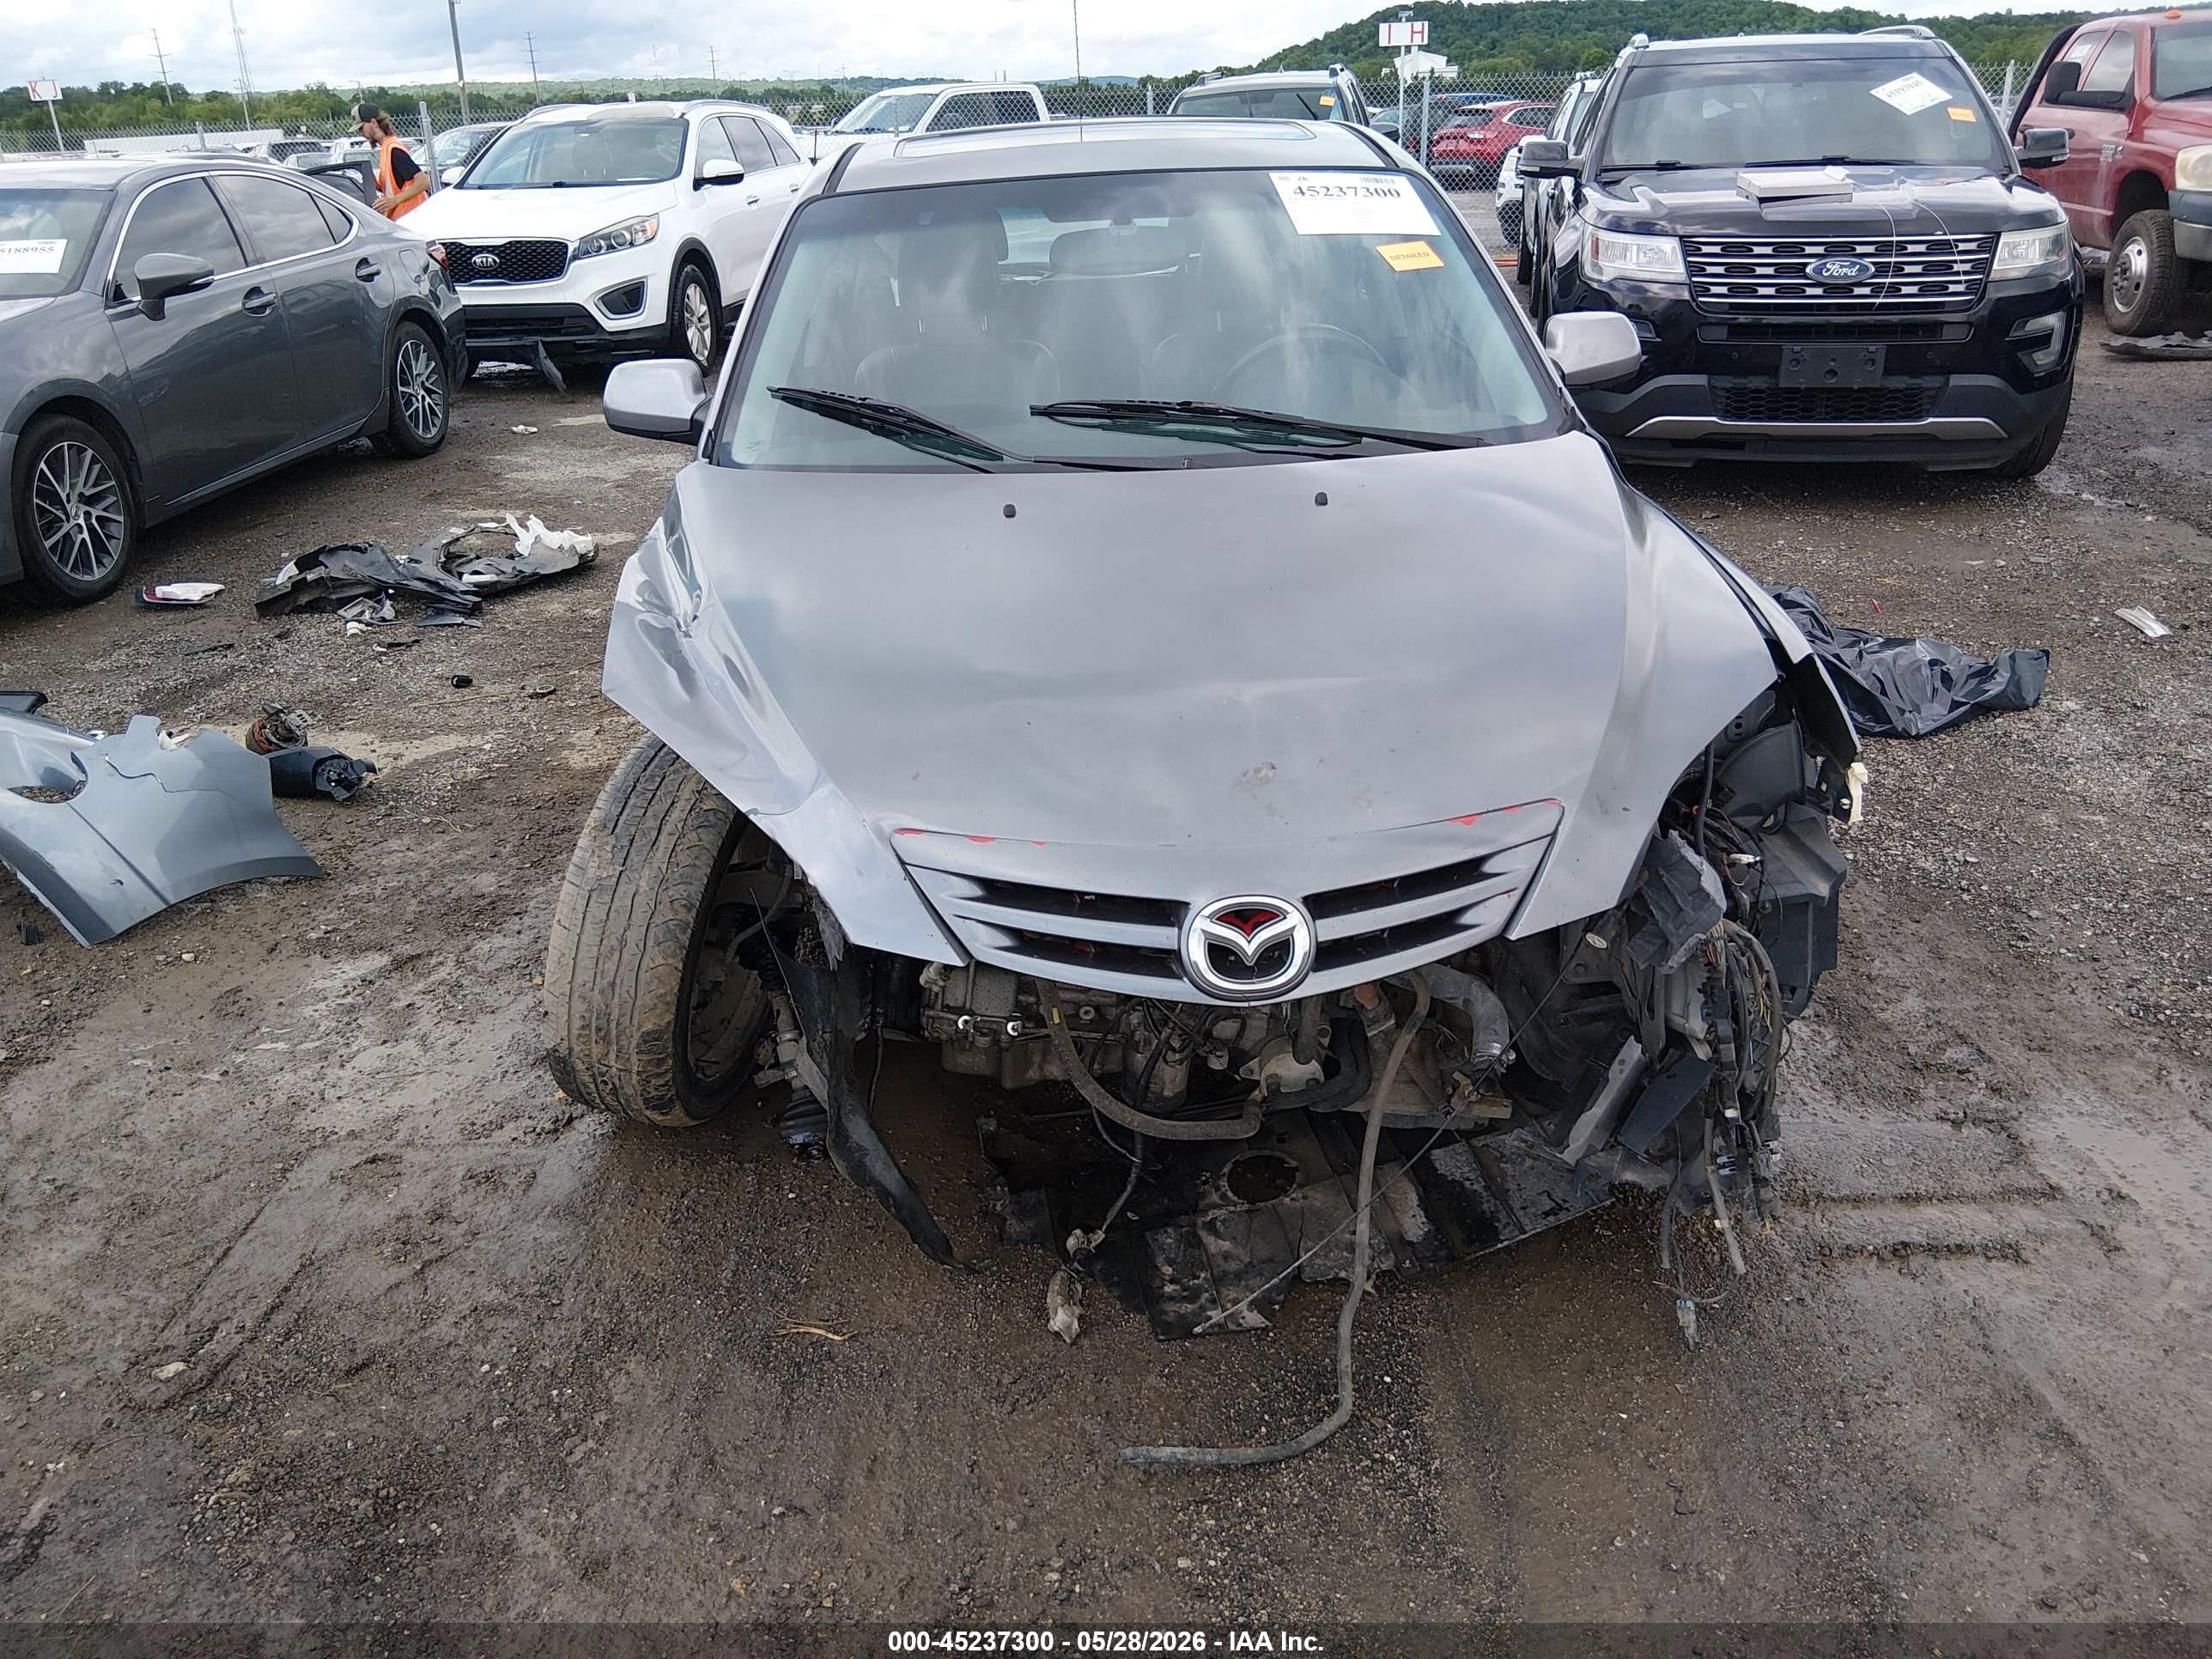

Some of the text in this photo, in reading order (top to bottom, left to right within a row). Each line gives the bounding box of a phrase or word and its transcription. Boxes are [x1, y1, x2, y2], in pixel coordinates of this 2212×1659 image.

[1411, 22, 1425, 43] H
[29, 81, 58, 100] K J
[1293, 185, 1401, 198] 45237300
[475, 257, 495, 267] KIA
[1390, 251, 1430, 261] DETAILED
[1822, 261, 1860, 276] Ford
